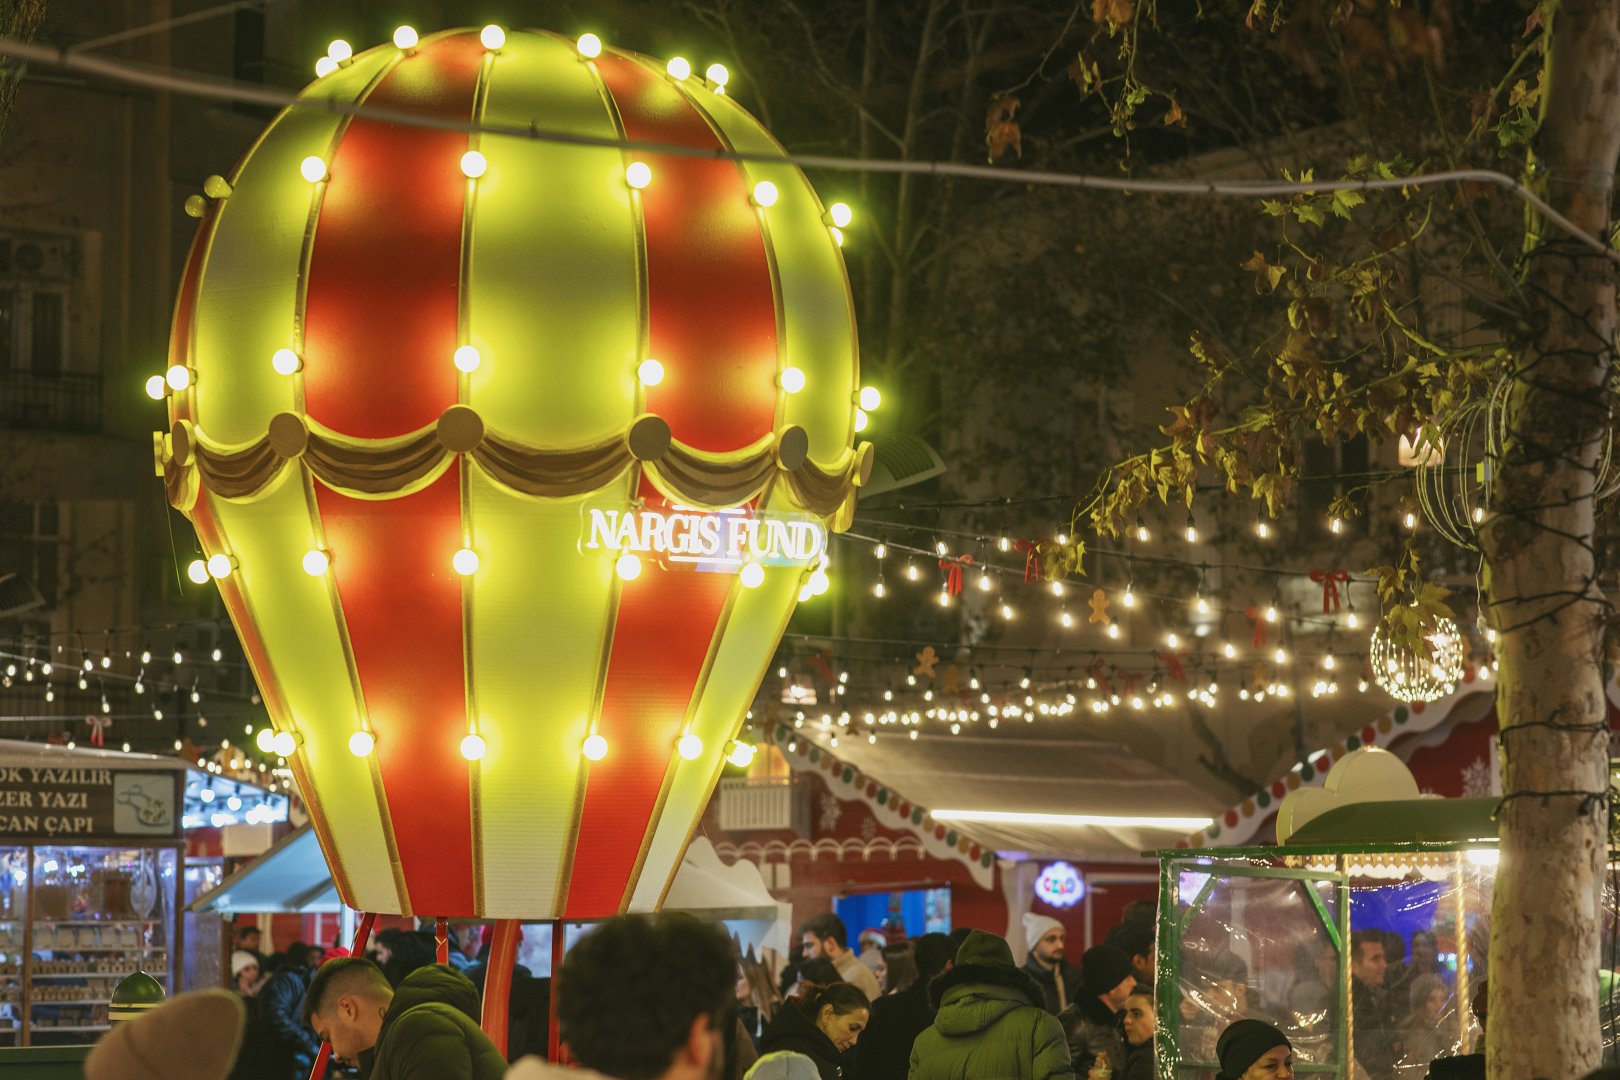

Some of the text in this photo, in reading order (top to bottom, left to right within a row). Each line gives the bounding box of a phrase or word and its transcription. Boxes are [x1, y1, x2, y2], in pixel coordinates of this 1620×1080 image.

[588, 508, 822, 560] NARGIS FUND
[30, 768, 112, 785] YAZILIR
[38, 792, 88, 808] YAZI
[44, 816, 93, 836] ÇAPI
